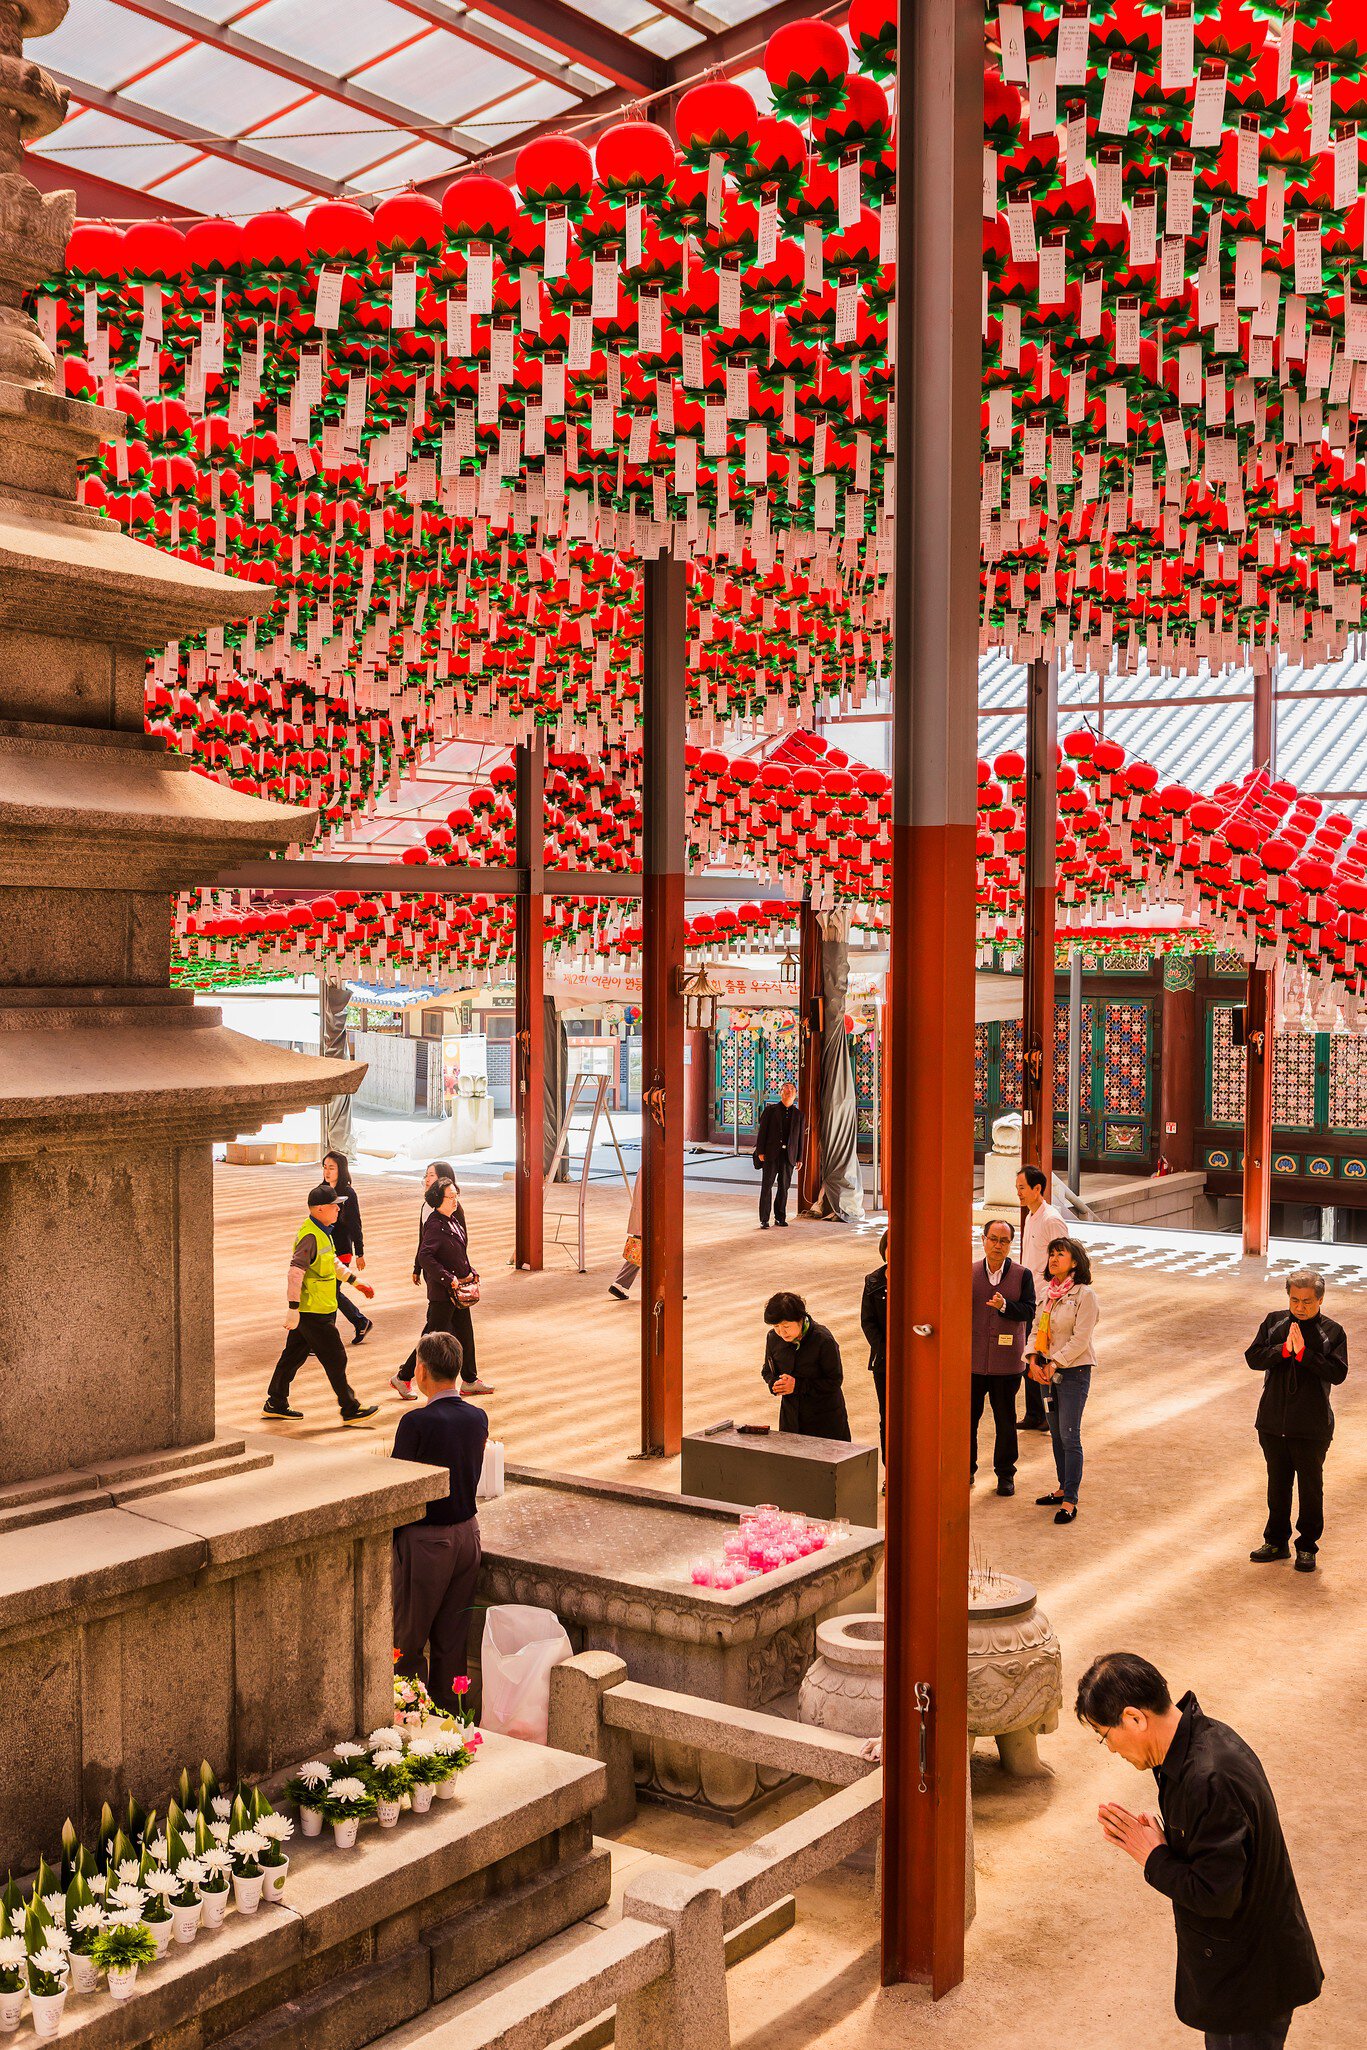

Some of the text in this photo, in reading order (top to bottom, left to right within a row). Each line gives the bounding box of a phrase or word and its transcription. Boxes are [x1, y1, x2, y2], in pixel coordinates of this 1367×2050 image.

[563, 973, 587, 985] 제2회
[591, 976, 621, 989] 어린이
[725, 979, 747, 994] 출품
[750, 979, 782, 994] 우수작
